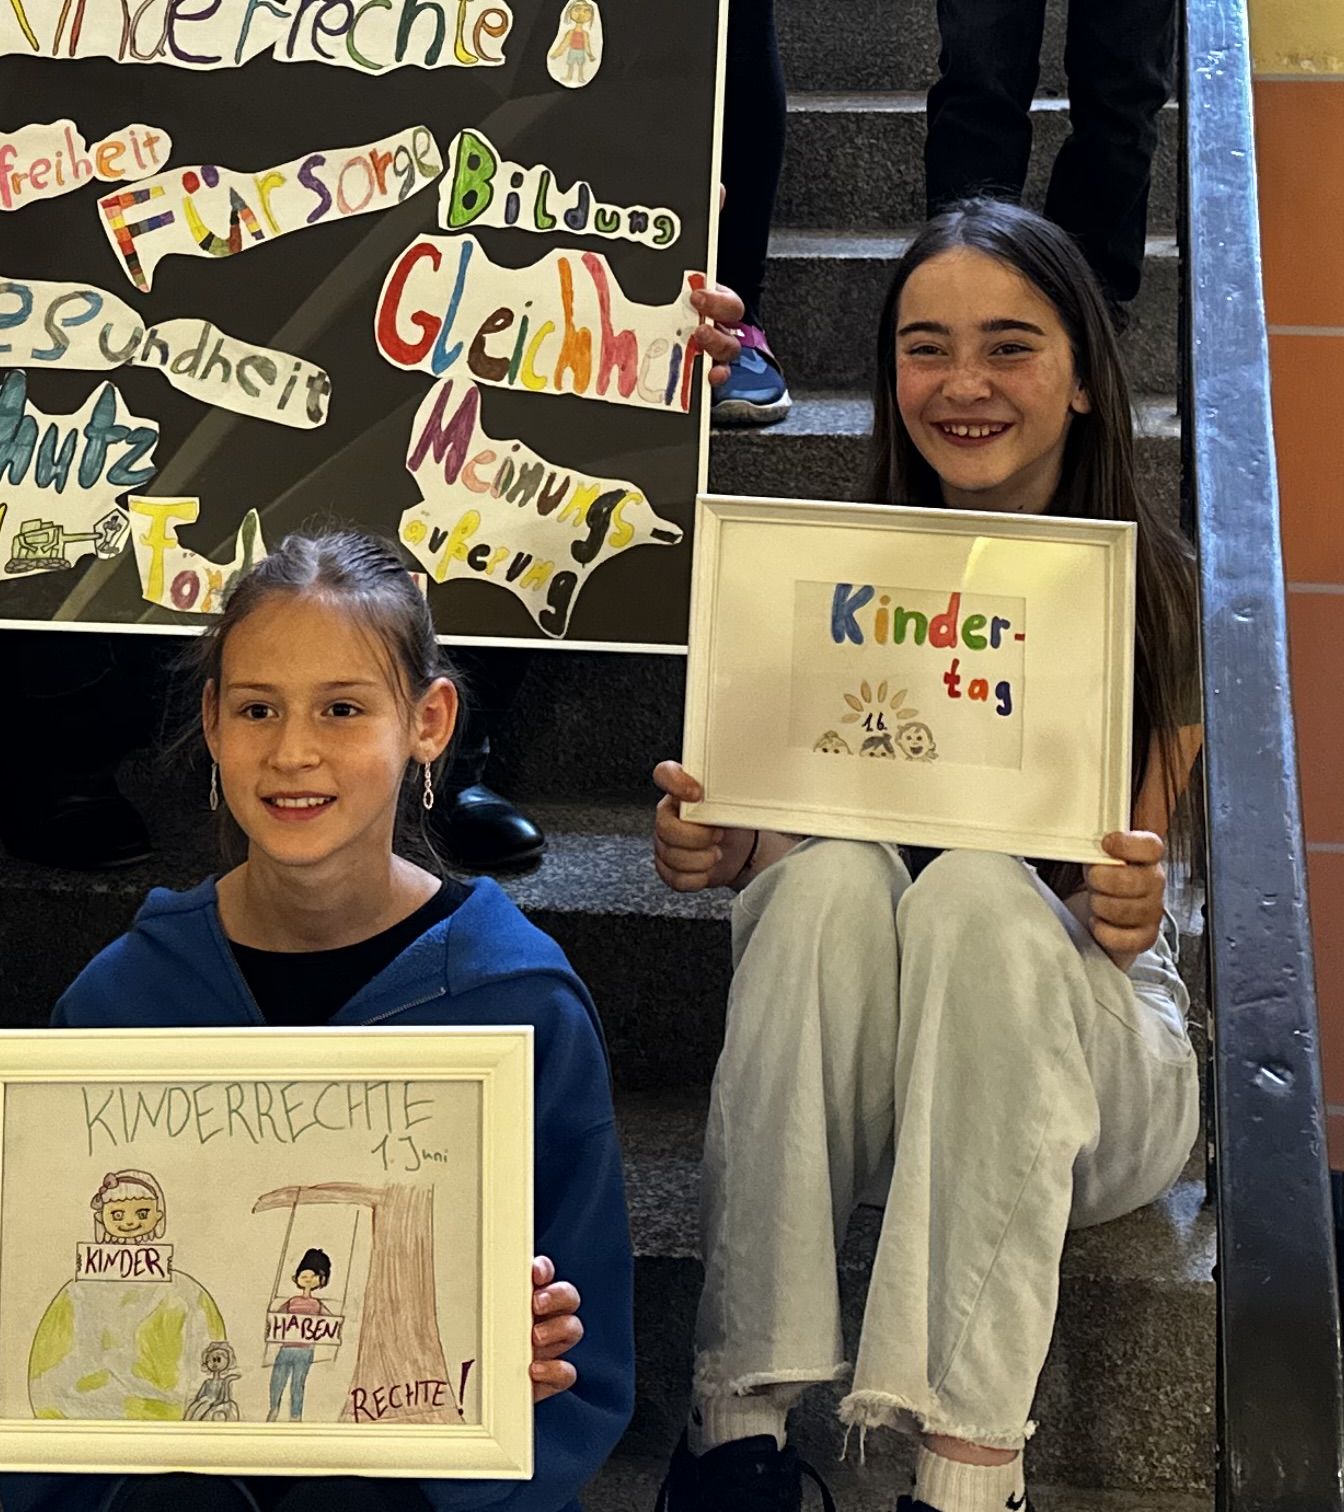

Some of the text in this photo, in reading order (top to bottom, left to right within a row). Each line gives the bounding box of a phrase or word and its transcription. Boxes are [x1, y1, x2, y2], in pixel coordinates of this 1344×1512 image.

[99, 126, 443, 292] Fürsorge
[447, 130, 675, 244] Bildung
[830, 583, 1025, 651] Kinder-
[943, 658, 1013, 717] tag
[1097, 679, 1156, 715] NIKE
[82, 1080, 436, 1158] KINDERRECHTE
[399, 1135, 449, 1173] Juni
[84, 1246, 166, 1280] KINDER
[272, 1314, 340, 1343] HABEN
